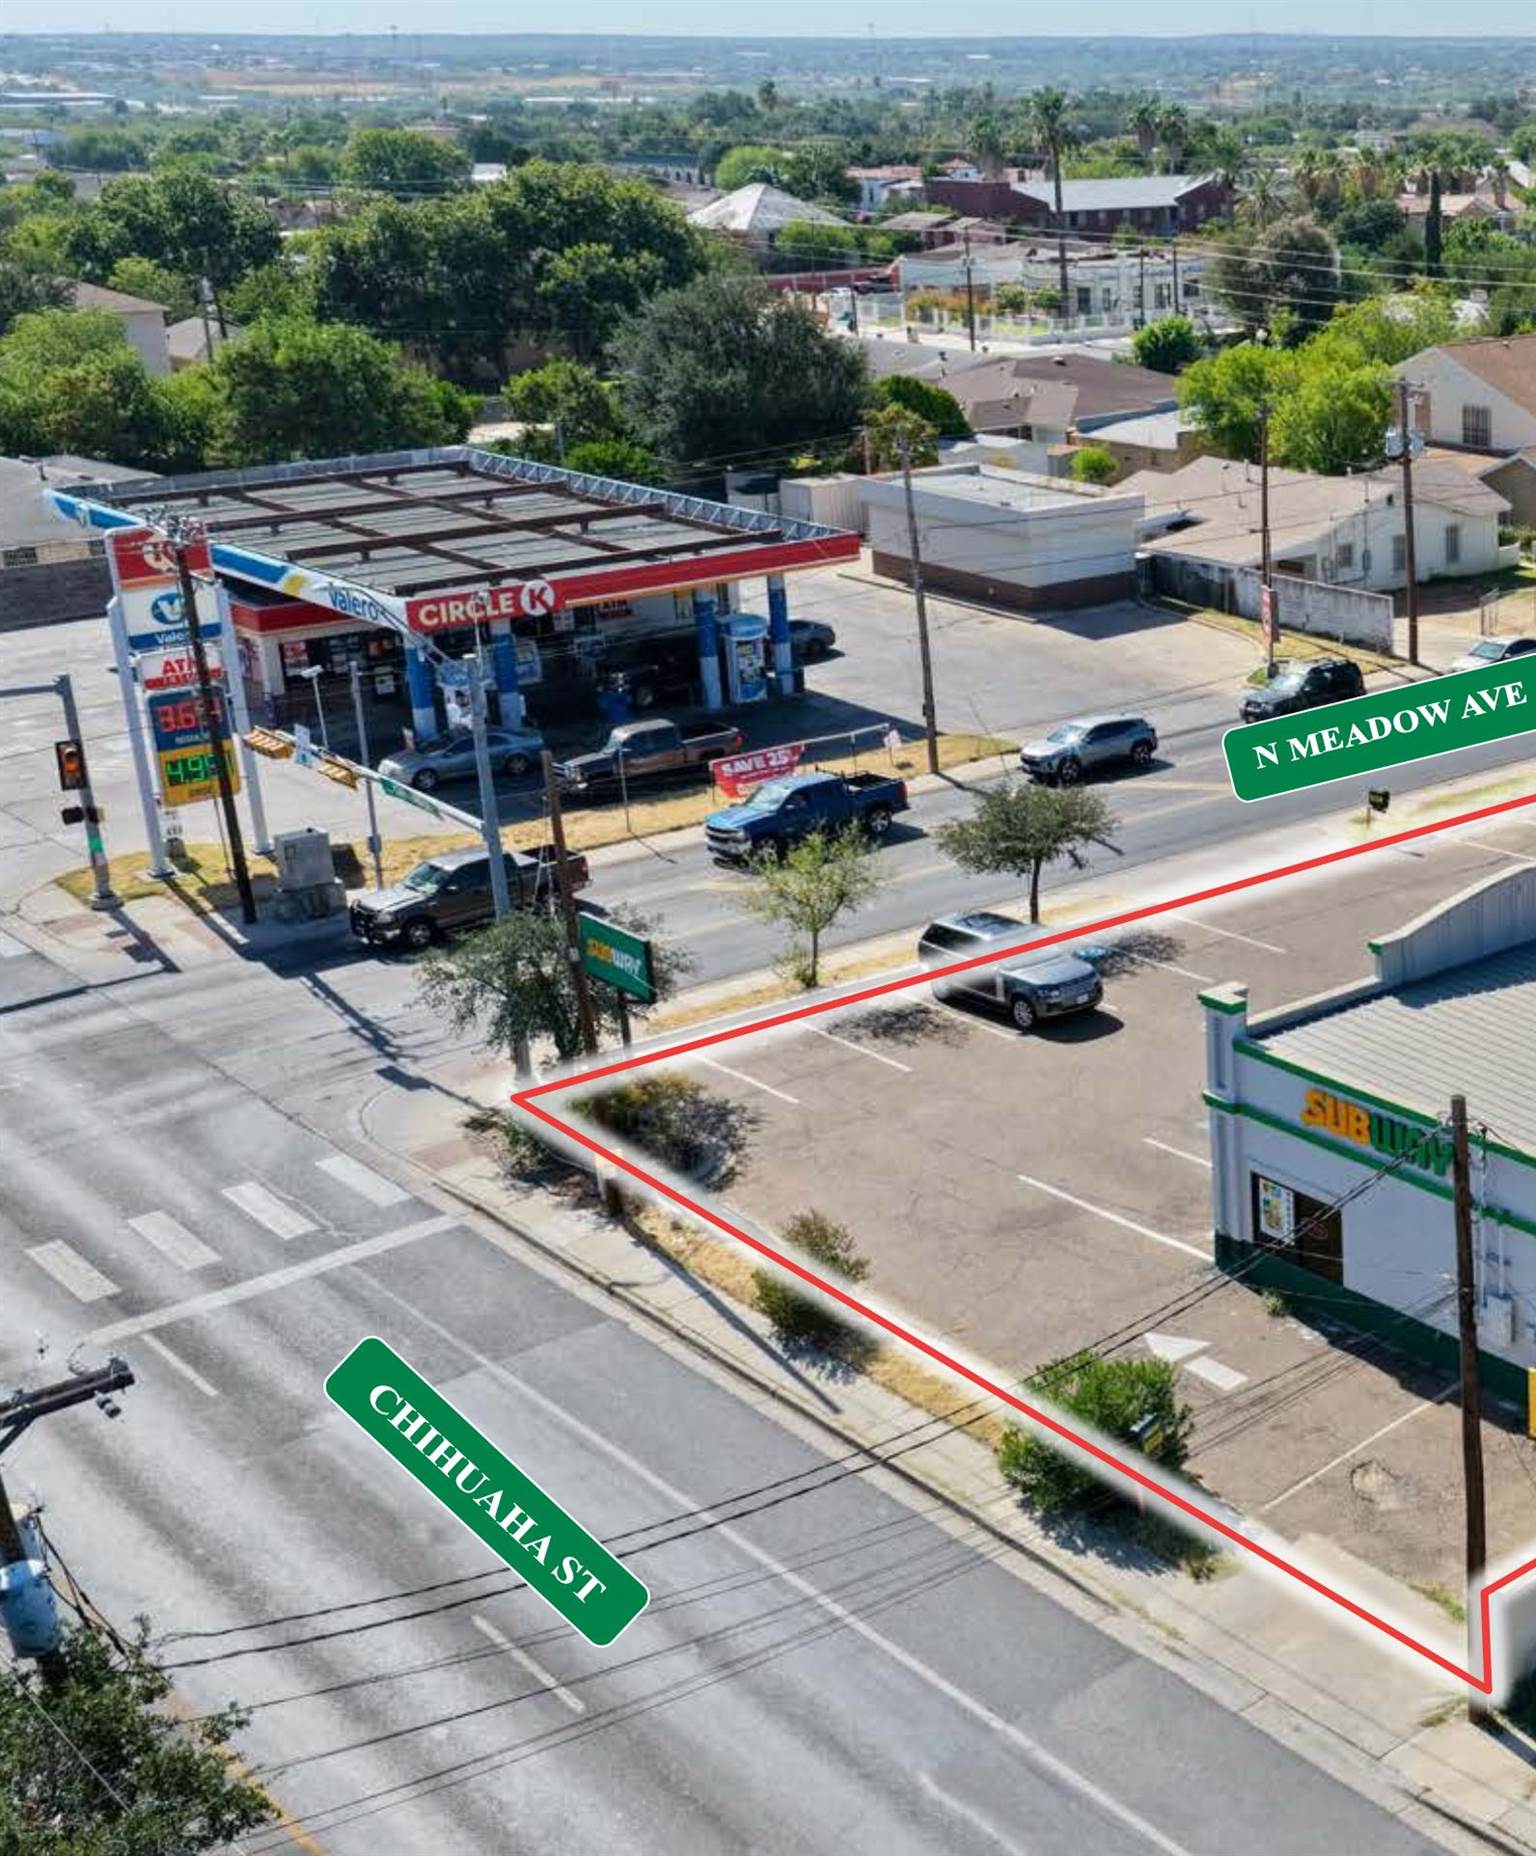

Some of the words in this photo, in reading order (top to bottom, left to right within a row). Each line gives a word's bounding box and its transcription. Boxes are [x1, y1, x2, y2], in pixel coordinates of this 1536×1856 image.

[328, 582, 379, 621] Valero
[418, 594, 514, 626] CIRCLE
[155, 629, 195, 645] Vale
[721, 756, 766, 777] SAVE
[586, 938, 642, 977] SUBWAY
[1302, 1088, 1456, 1177] SUBWAY
